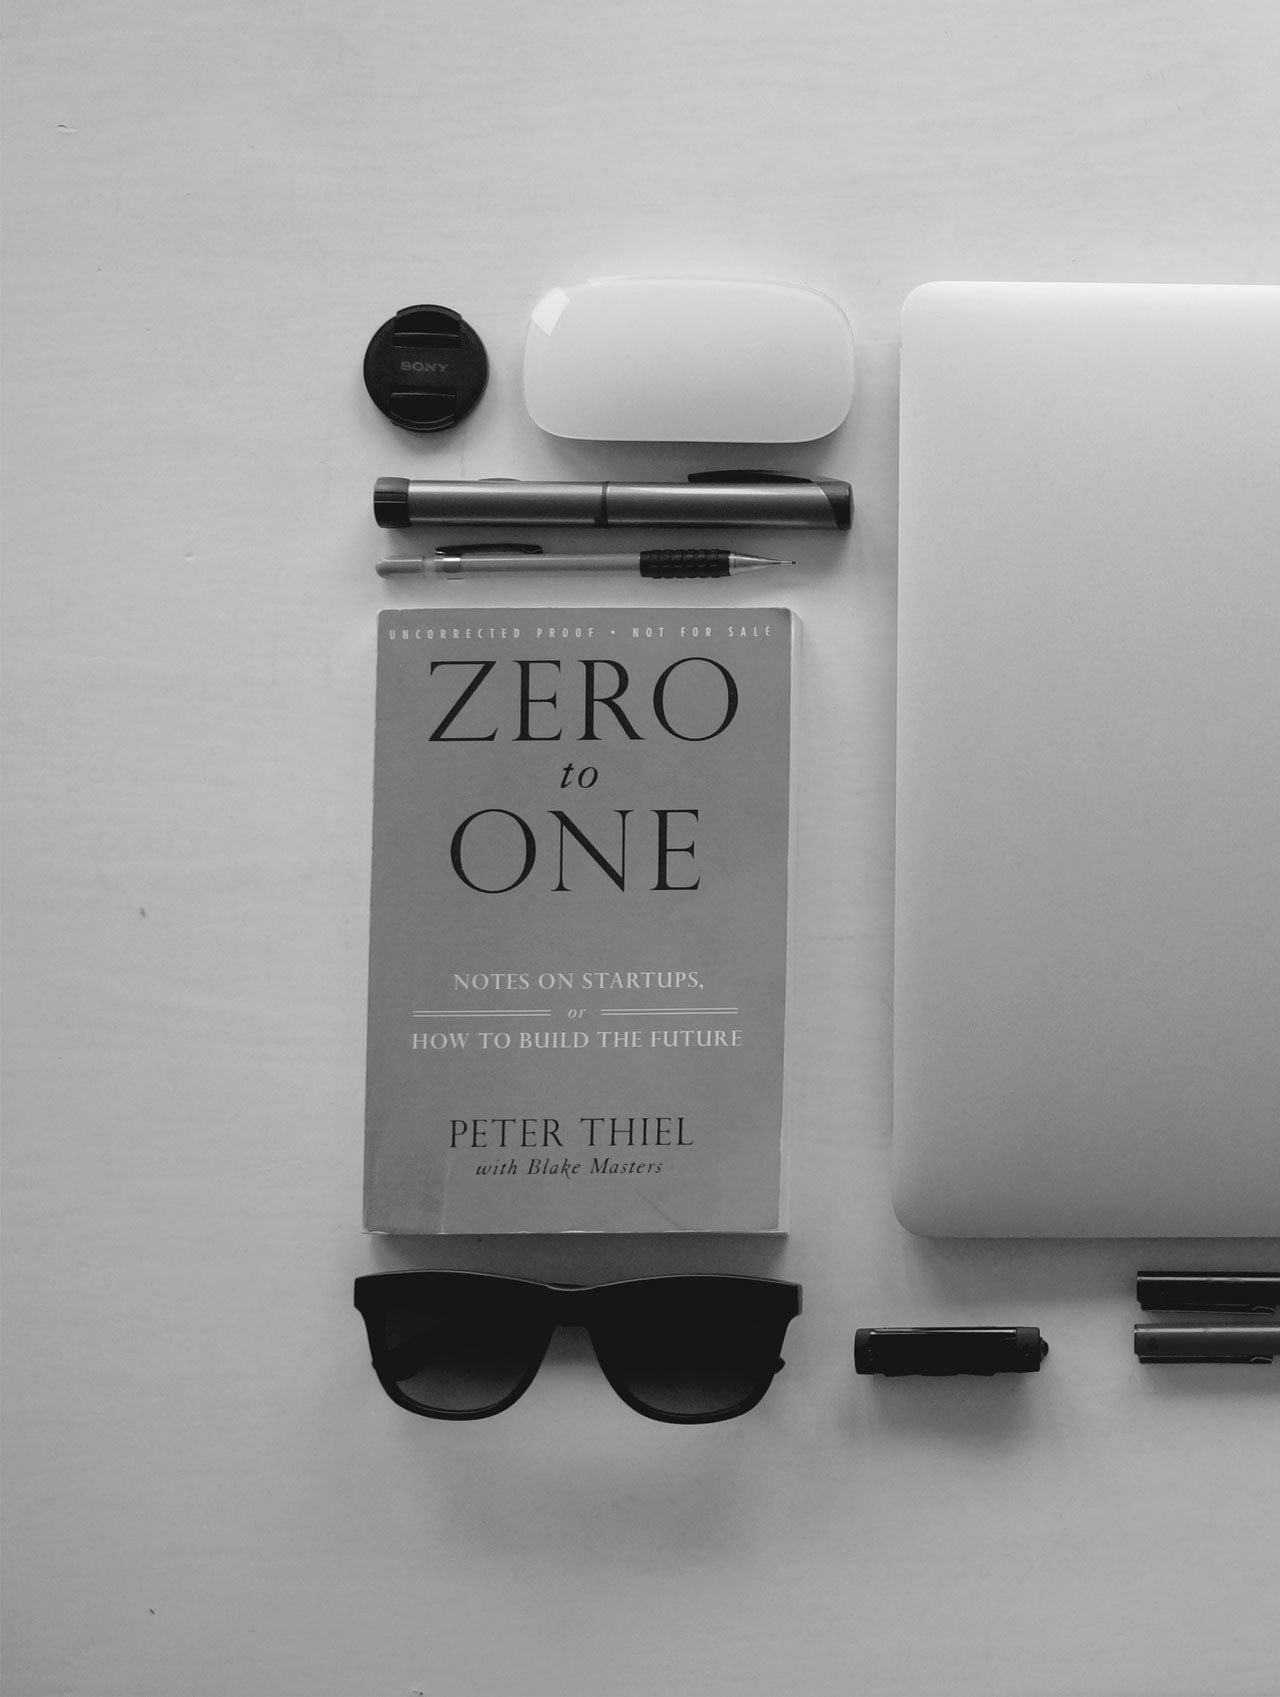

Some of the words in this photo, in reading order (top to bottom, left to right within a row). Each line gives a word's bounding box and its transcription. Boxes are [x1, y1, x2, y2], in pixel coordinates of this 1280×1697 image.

[401, 361, 449, 372] SONY
[389, 627, 520, 640] UNCORRECTED
[536, 627, 594, 638] PROOF
[632, 627, 665, 638] NOT
[680, 626, 712, 637] FOR
[728, 626, 771, 637] SALE
[428, 657, 739, 742] ZERO
[560, 762, 599, 789] to
[450, 808, 701, 894] ONE
[454, 973, 530, 991] NOTES
[538, 972, 574, 990] ON
[582, 971, 704, 991] STARTUPS,
[567, 1007, 587, 1019] or
[412, 1032, 470, 1050] HOW
[478, 1032, 511, 1049] TO
[519, 1031, 589, 1049] BUILD
[596, 1031, 643, 1048] THE
[651, 1029, 742, 1048] FUTURE
[449, 1118, 564, 1148] PETER
[580, 1117, 694, 1147] THIEL
[475, 1158, 518, 1176] with
[527, 1157, 581, 1179] Blake
[590, 1157, 663, 1175] Masters
